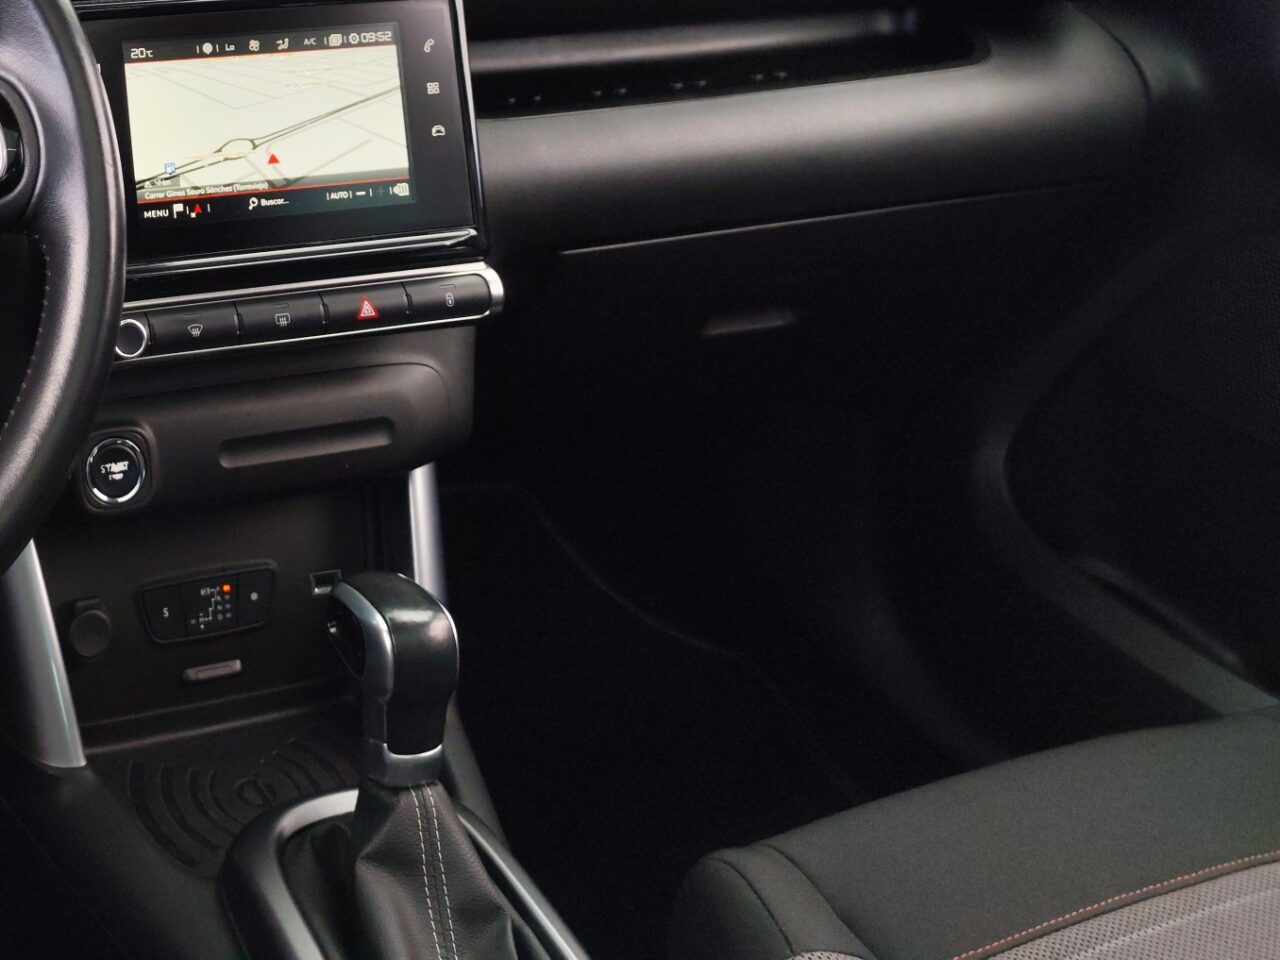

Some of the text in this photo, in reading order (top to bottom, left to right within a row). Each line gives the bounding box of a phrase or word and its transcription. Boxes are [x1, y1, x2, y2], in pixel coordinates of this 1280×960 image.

[360, 31, 392, 43] 09:52
[330, 191, 349, 200] AUTO
[144, 209, 169, 219] MENU
[163, 607, 169, 617] S
